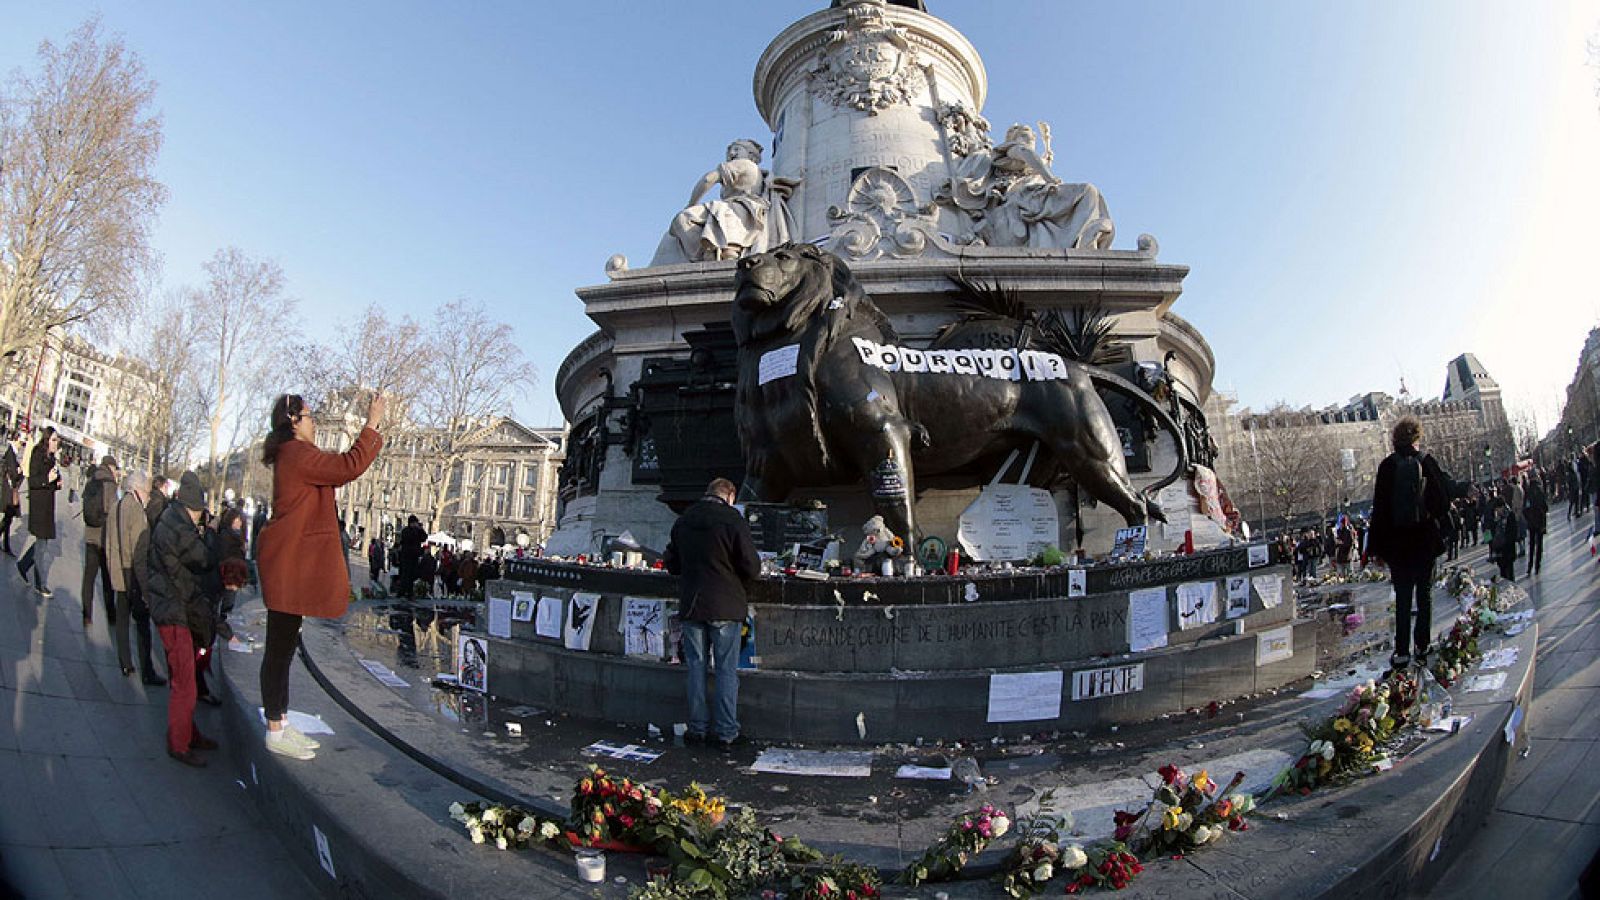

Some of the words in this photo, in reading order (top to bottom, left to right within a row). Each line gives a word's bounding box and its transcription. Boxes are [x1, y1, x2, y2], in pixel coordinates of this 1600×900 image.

[773, 626, 796, 646] LA
[799, 625, 856, 647] GRANDE
[918, 624, 932, 643] DE
[1065, 614, 1084, 632] LA
[1090, 607, 1126, 632] PAIX
